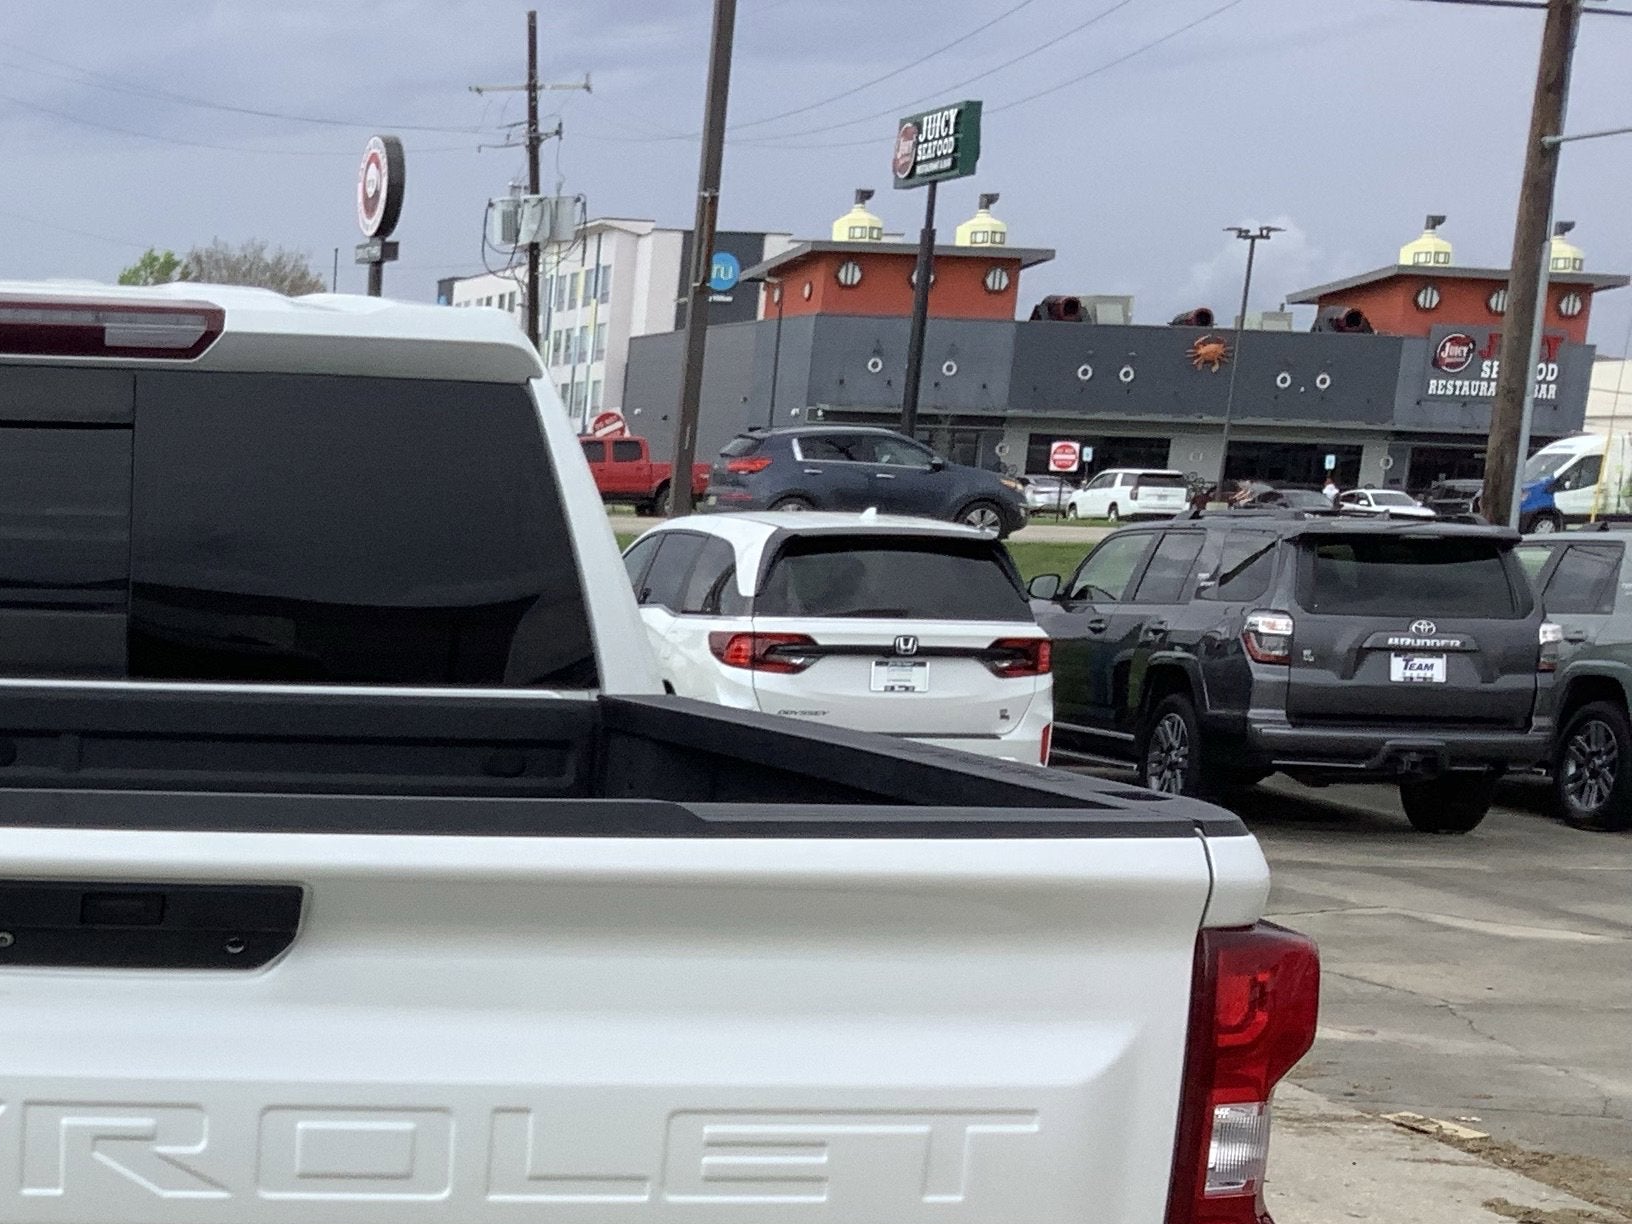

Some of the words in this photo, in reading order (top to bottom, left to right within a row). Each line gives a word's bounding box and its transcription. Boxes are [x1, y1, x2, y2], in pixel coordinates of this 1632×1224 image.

[918, 108, 958, 142] JUICY
[916, 136, 955, 161] SEAFOOD
[711, 263, 733, 281] ru
[1428, 379, 1497, 397] RESTAURA
[1402, 657, 1435, 672] TEAM
